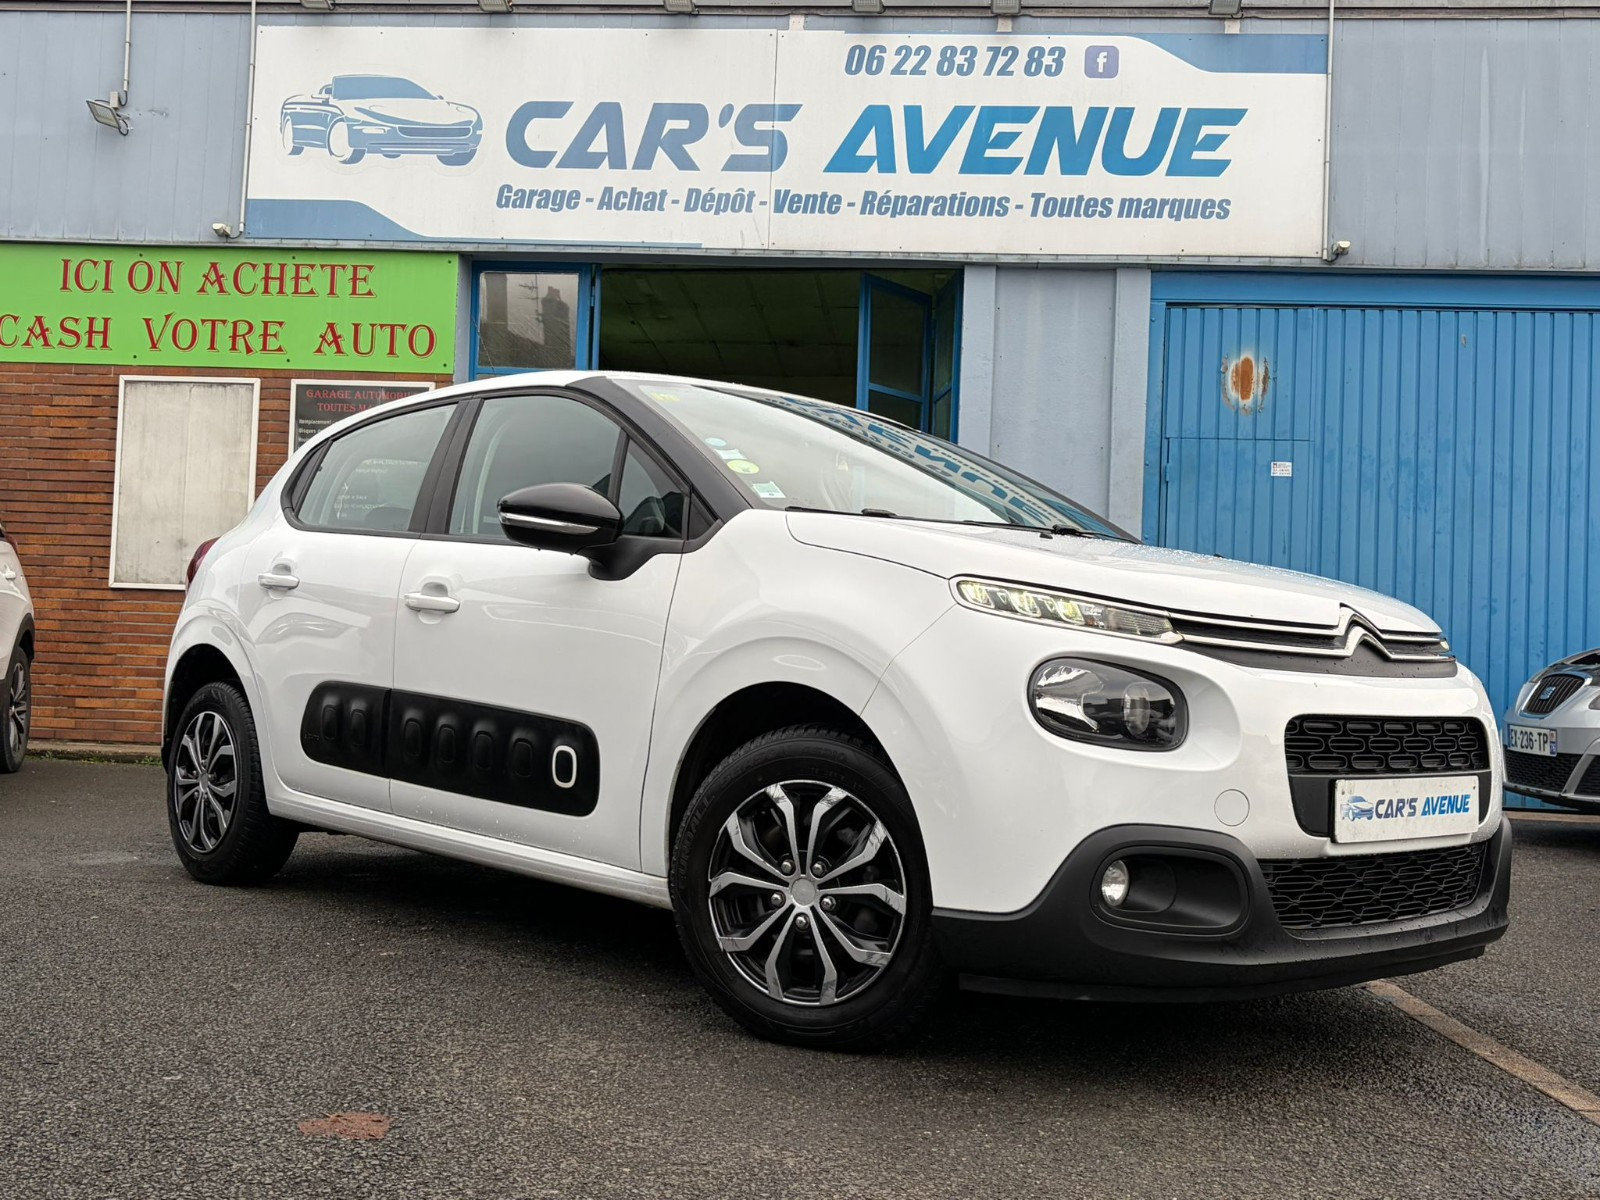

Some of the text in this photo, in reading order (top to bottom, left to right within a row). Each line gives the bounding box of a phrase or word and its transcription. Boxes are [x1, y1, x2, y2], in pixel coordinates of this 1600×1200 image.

[844, 45, 1066, 77] 06 22 83 72 83
[506, 101, 1249, 178] CAR'S AVENUE
[496, 184, 581, 211] Garage
[598, 187, 667, 211] Achat
[684, 188, 755, 215] Dépôt
[773, 189, 842, 215] Vente
[860, 190, 1011, 219] Réparations
[1030, 192, 1113, 219] Toutes
[1117, 197, 1231, 222] marques
[60, 258, 377, 298] ICI ON ACHETE
[0, 313, 437, 358] CASH VOTRE AUTO
[306, 389, 351, 399] GARAGE
[317, 403, 356, 412] TOUTES
[1510, 728, 1548, 752] EX-236-TP
[1375, 794, 1471, 819] CAR'S AVENUE
